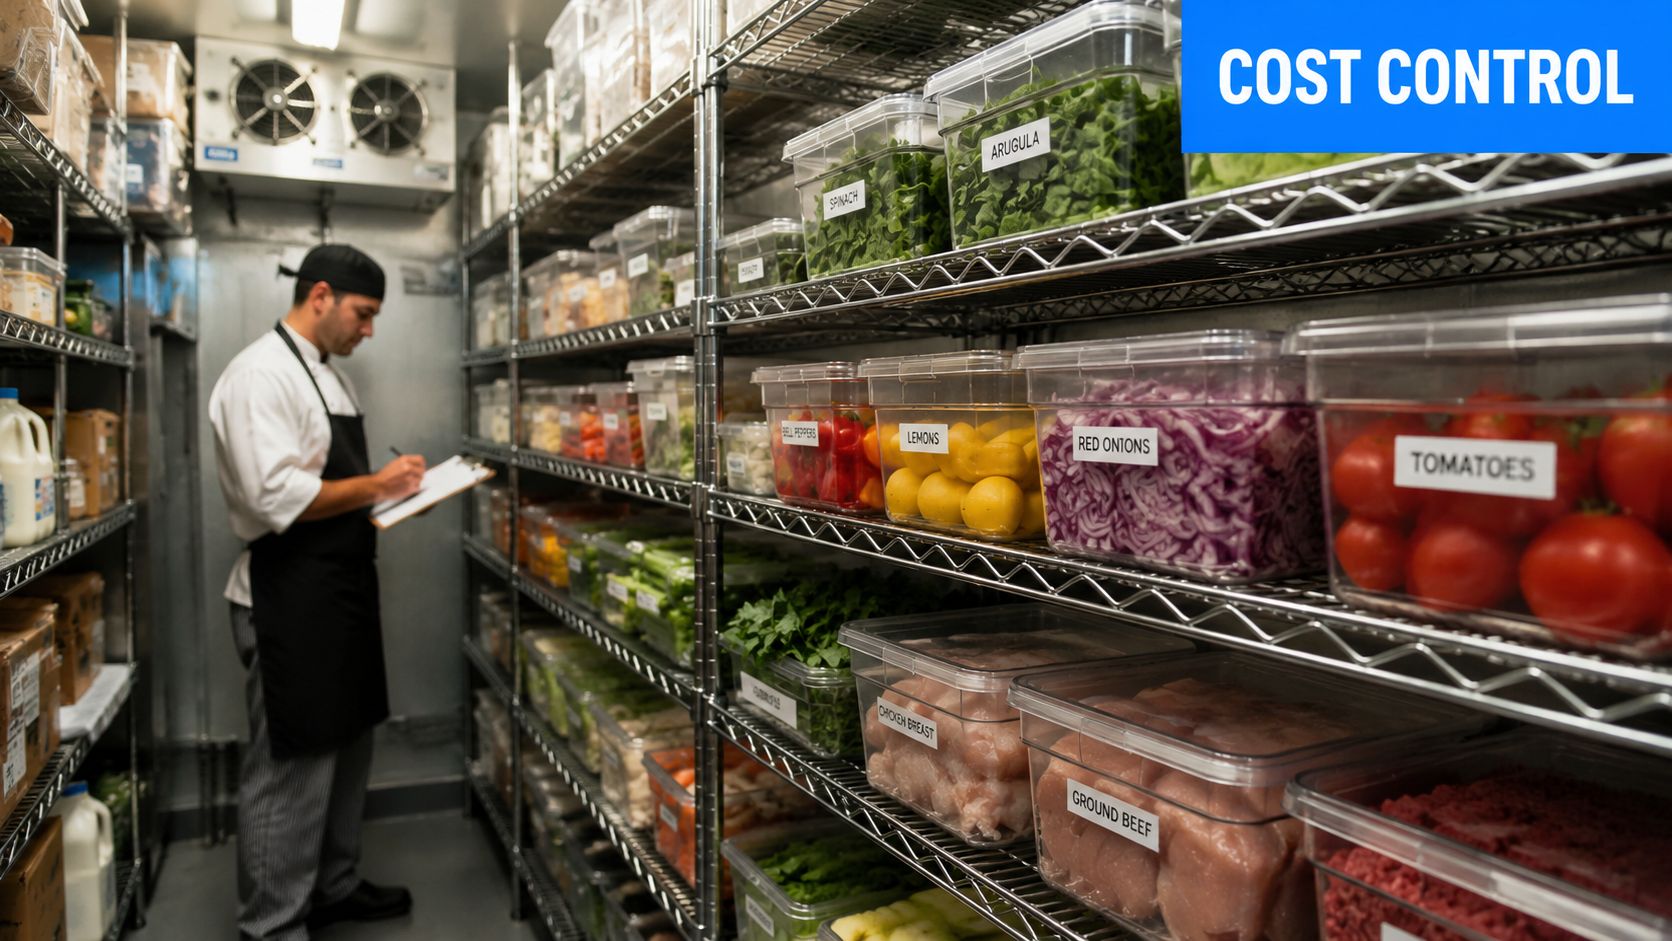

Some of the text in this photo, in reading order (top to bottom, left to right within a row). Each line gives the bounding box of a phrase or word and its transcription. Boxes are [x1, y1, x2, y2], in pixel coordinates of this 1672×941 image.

[991, 130, 1040, 160] ARUGULA
[829, 189, 858, 210] SPINACH
[907, 431, 940, 445] LEMONS
[1078, 436, 1151, 454] RED ONIONS
[1411, 451, 1535, 482] TOMATOES
[907, 718, 934, 740] BREAST
[1072, 790, 1152, 837] GROUND BEEF
